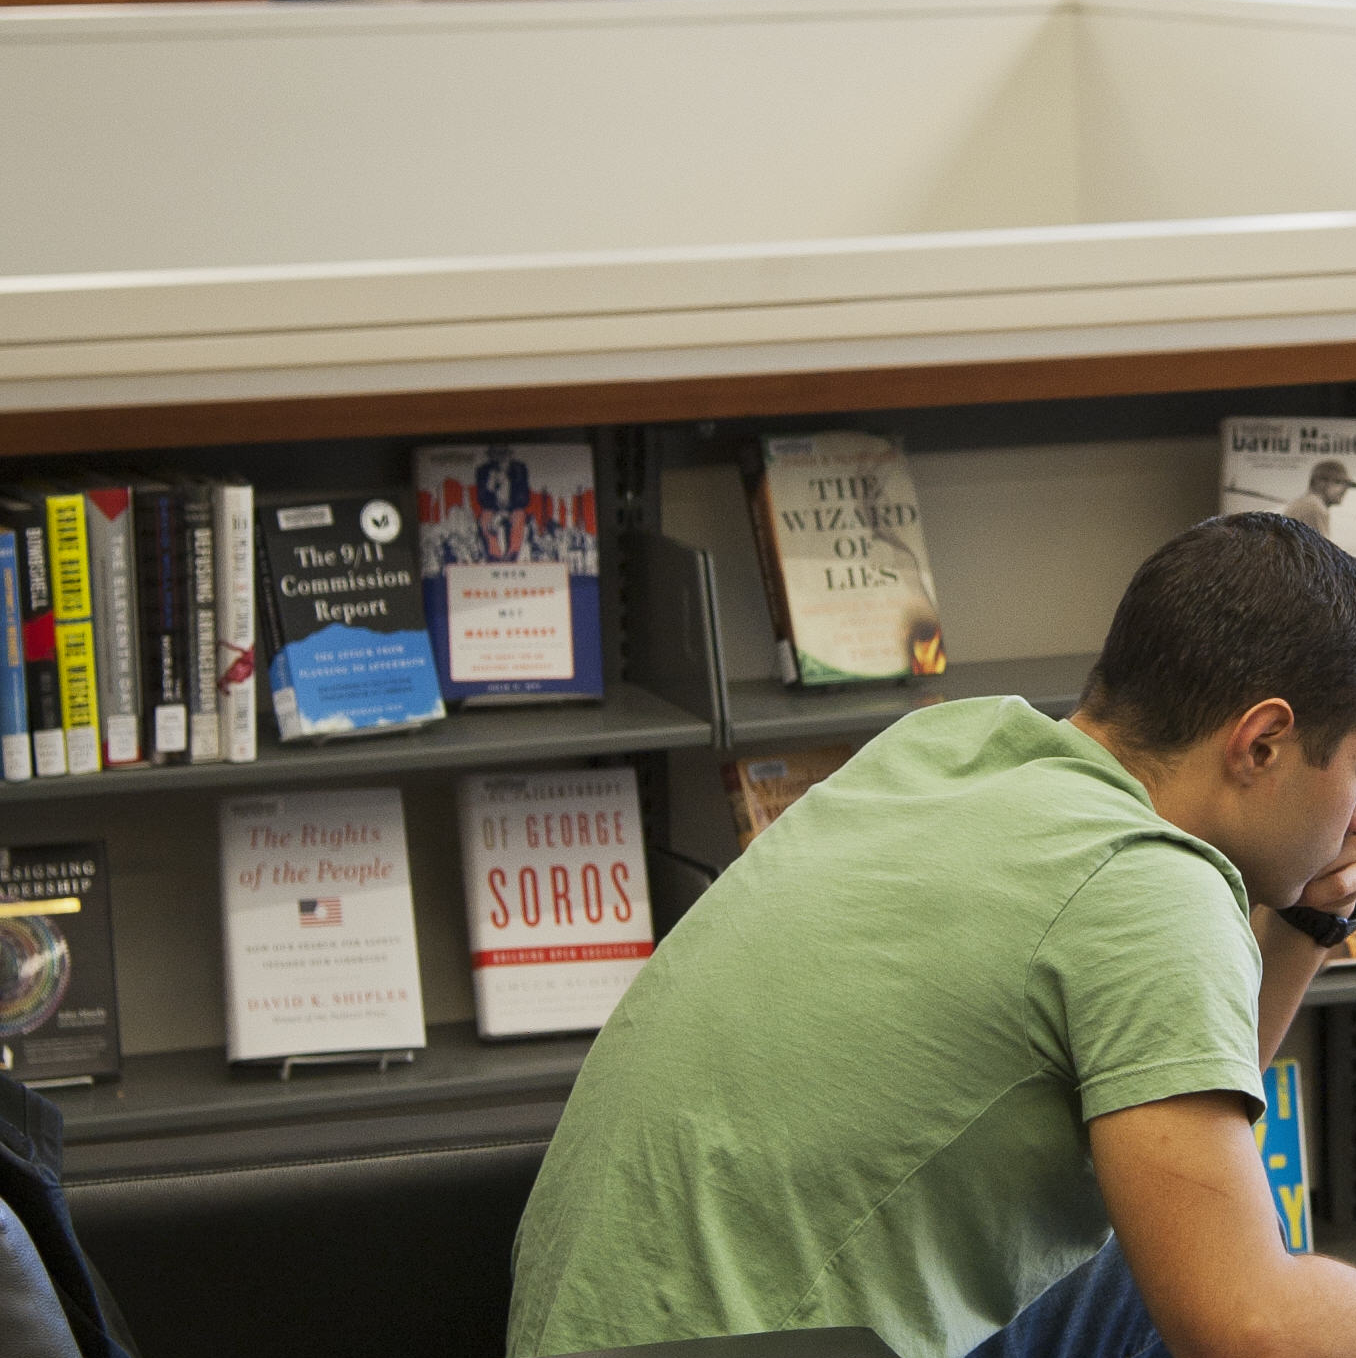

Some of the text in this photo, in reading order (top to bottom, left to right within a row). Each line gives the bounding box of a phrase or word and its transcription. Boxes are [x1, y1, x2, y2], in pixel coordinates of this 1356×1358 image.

[781, 503, 917, 532] WIZARD
[294, 542, 384, 569] The 9/11
[833, 535, 870, 559] OF
[280, 566, 412, 598] Commission
[314, 598, 388, 624] Report
[248, 822, 383, 851] The Rights
[525, 810, 626, 849] GEORGE
[239, 857, 394, 890] of the People
[487, 860, 633, 930] SOROS
[247, 994, 305, 1012] DAVID
